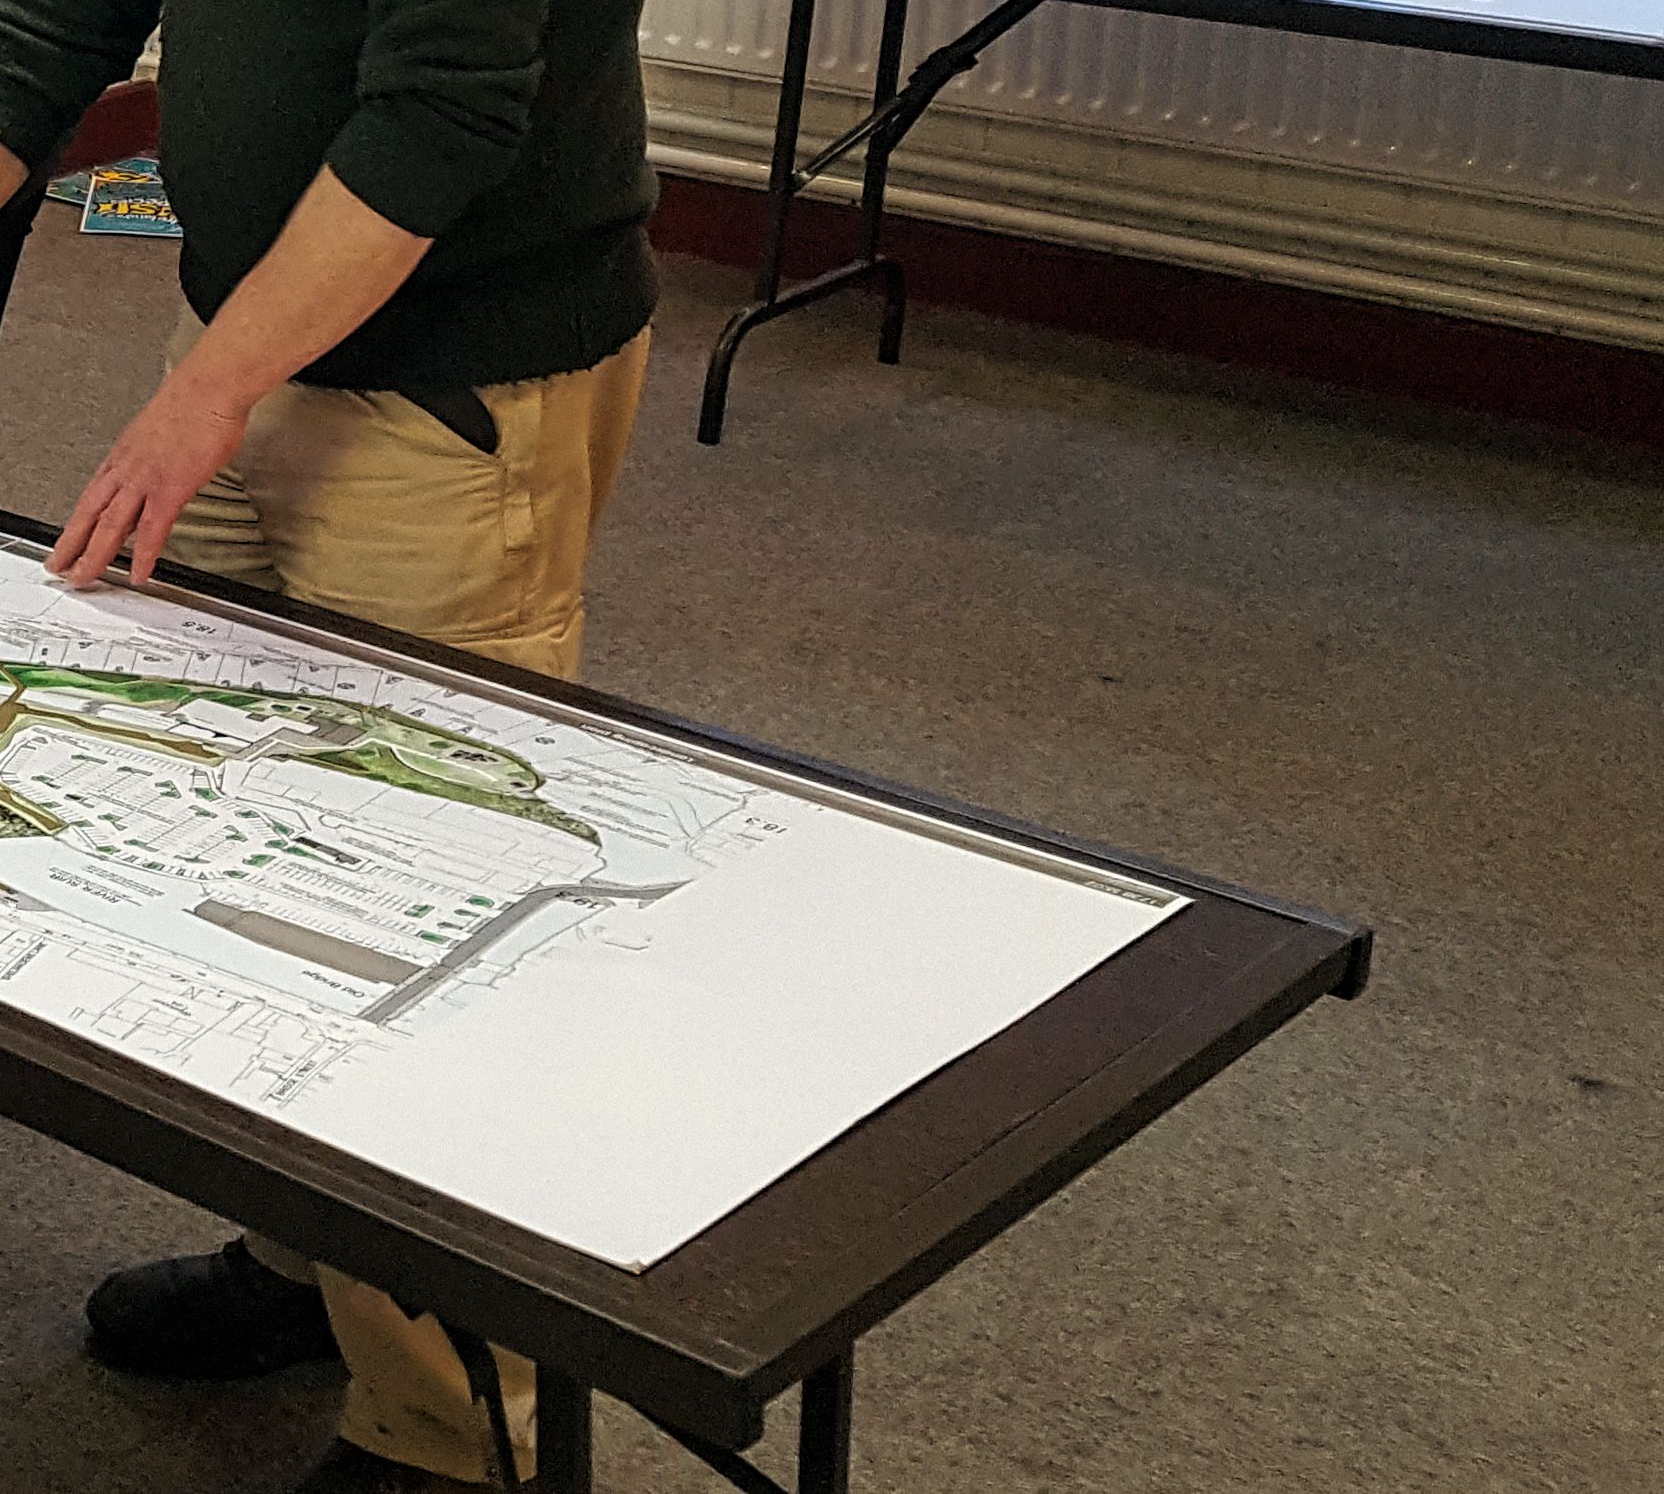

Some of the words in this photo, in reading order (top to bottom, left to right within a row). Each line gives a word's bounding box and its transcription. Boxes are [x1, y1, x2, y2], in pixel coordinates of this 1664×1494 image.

[82, 886, 120, 904] RIVER
[302, 971, 341, 989] Bridge
[341, 987, 365, 998] Old
